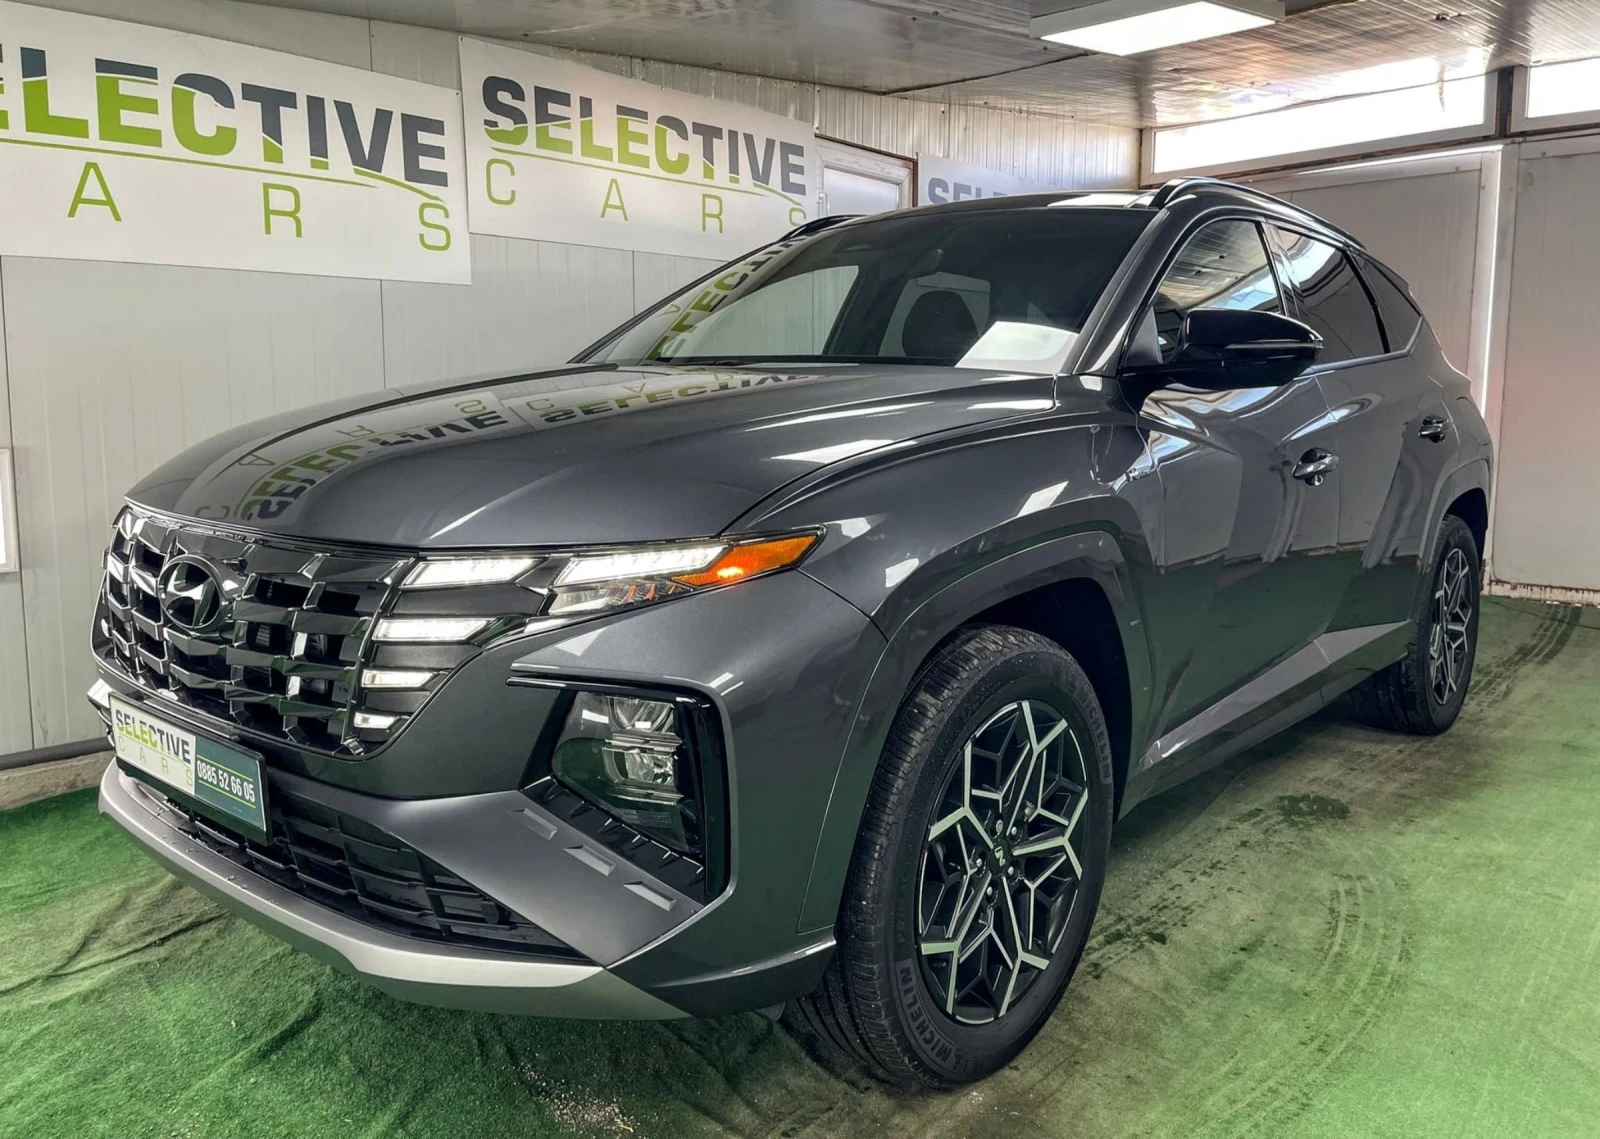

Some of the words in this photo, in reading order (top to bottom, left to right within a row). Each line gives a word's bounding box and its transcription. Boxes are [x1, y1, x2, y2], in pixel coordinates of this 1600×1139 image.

[0, 44, 448, 187] LECTIVE
[482, 76, 806, 196] SELECTIVE
[115, 709, 191, 765] SELECTIVE
[117, 735, 193, 787] CARS
[1076, 688, 1112, 779] MICHELIN
[196, 760, 217, 786] 0885
[218, 770, 229, 791] 52
[231, 775, 242, 797] 66
[243, 781, 256, 803] 05
[899, 966, 953, 1063] MICHELIN
